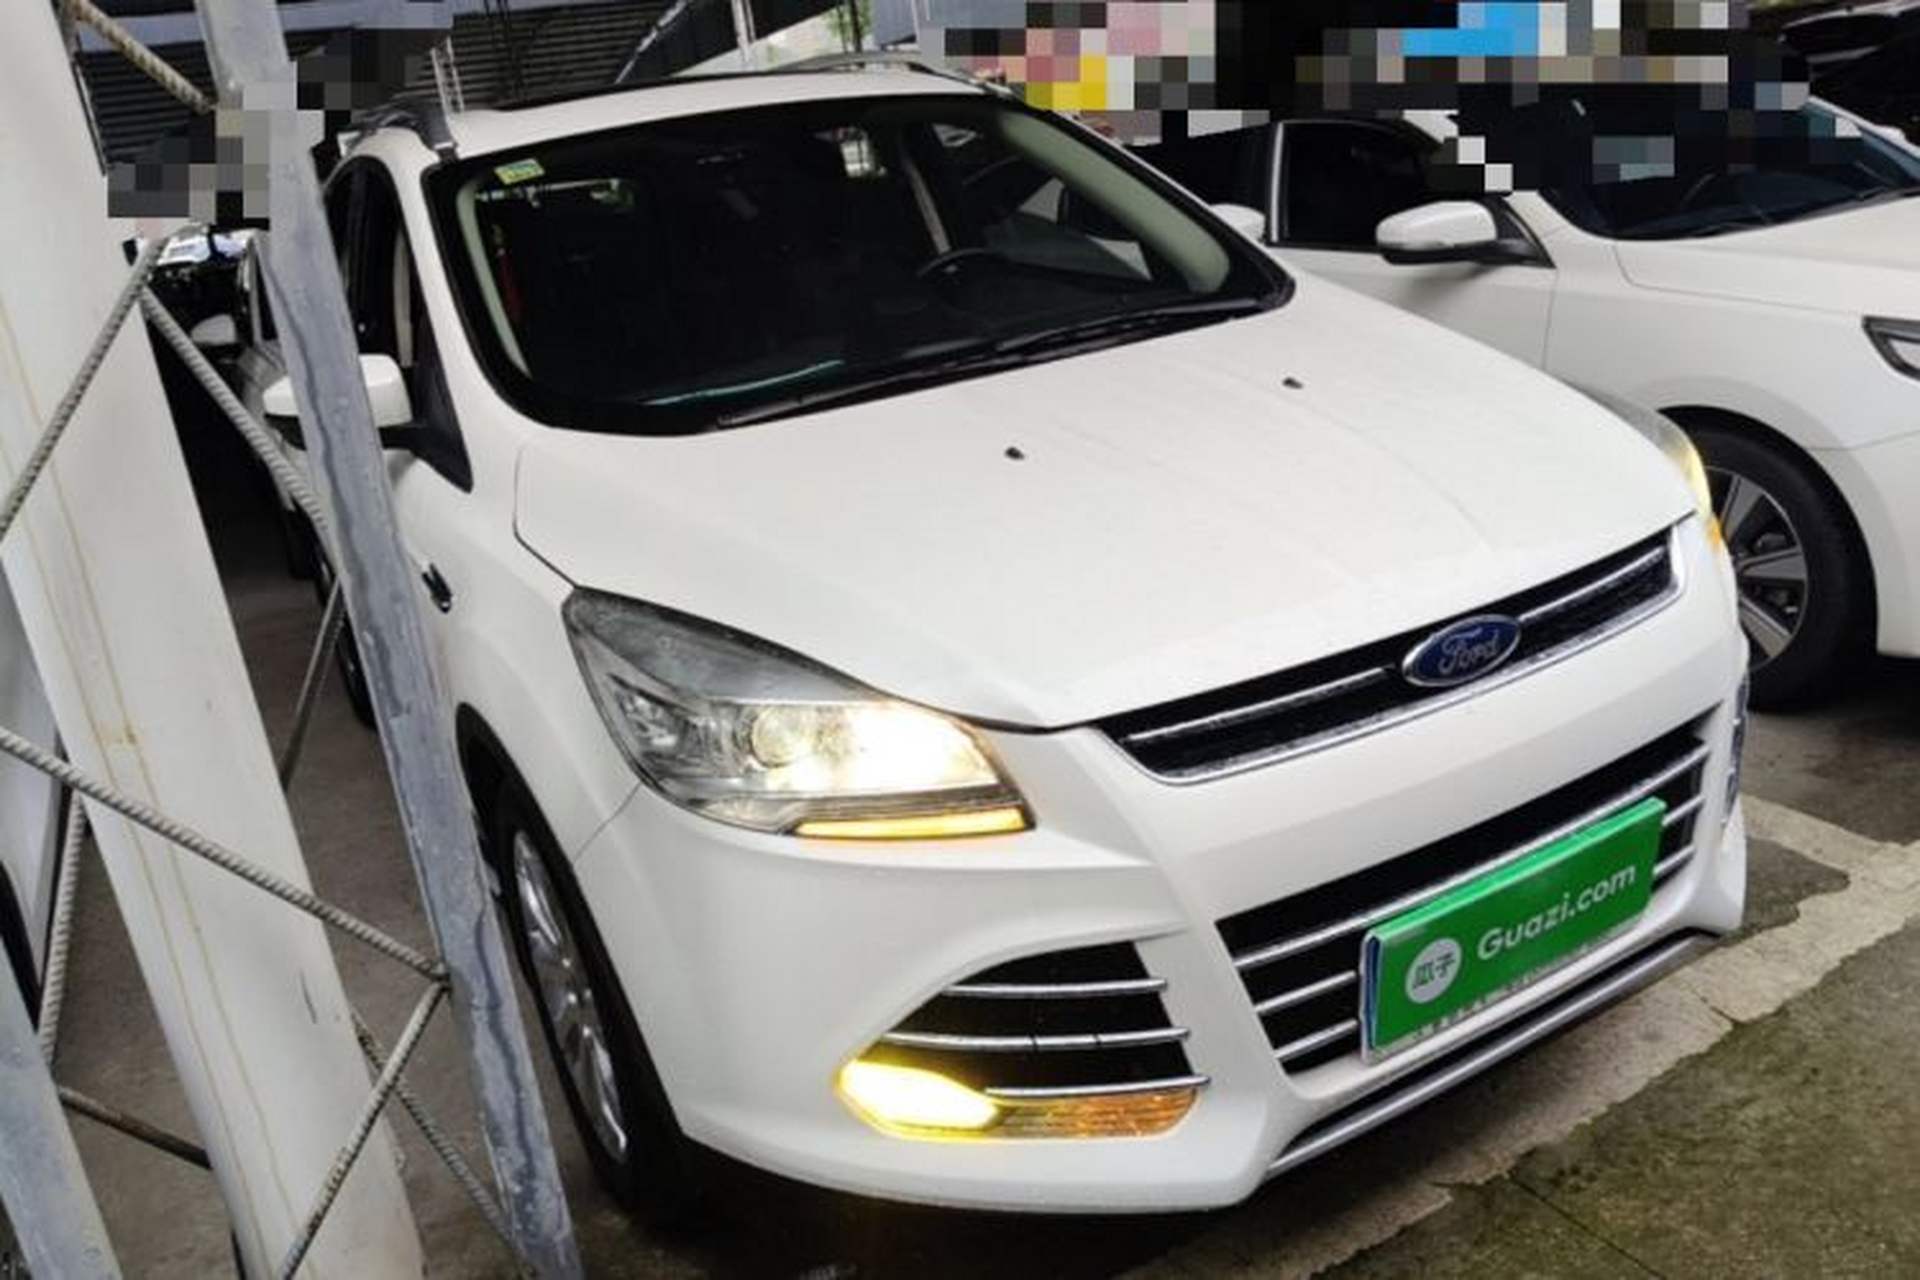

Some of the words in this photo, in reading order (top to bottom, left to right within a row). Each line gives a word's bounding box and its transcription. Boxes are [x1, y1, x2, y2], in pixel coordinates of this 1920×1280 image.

[1438, 626, 1499, 675] Ford
[1476, 864, 1637, 961] Guazi.com
[1412, 950, 1456, 989] 瓜子
